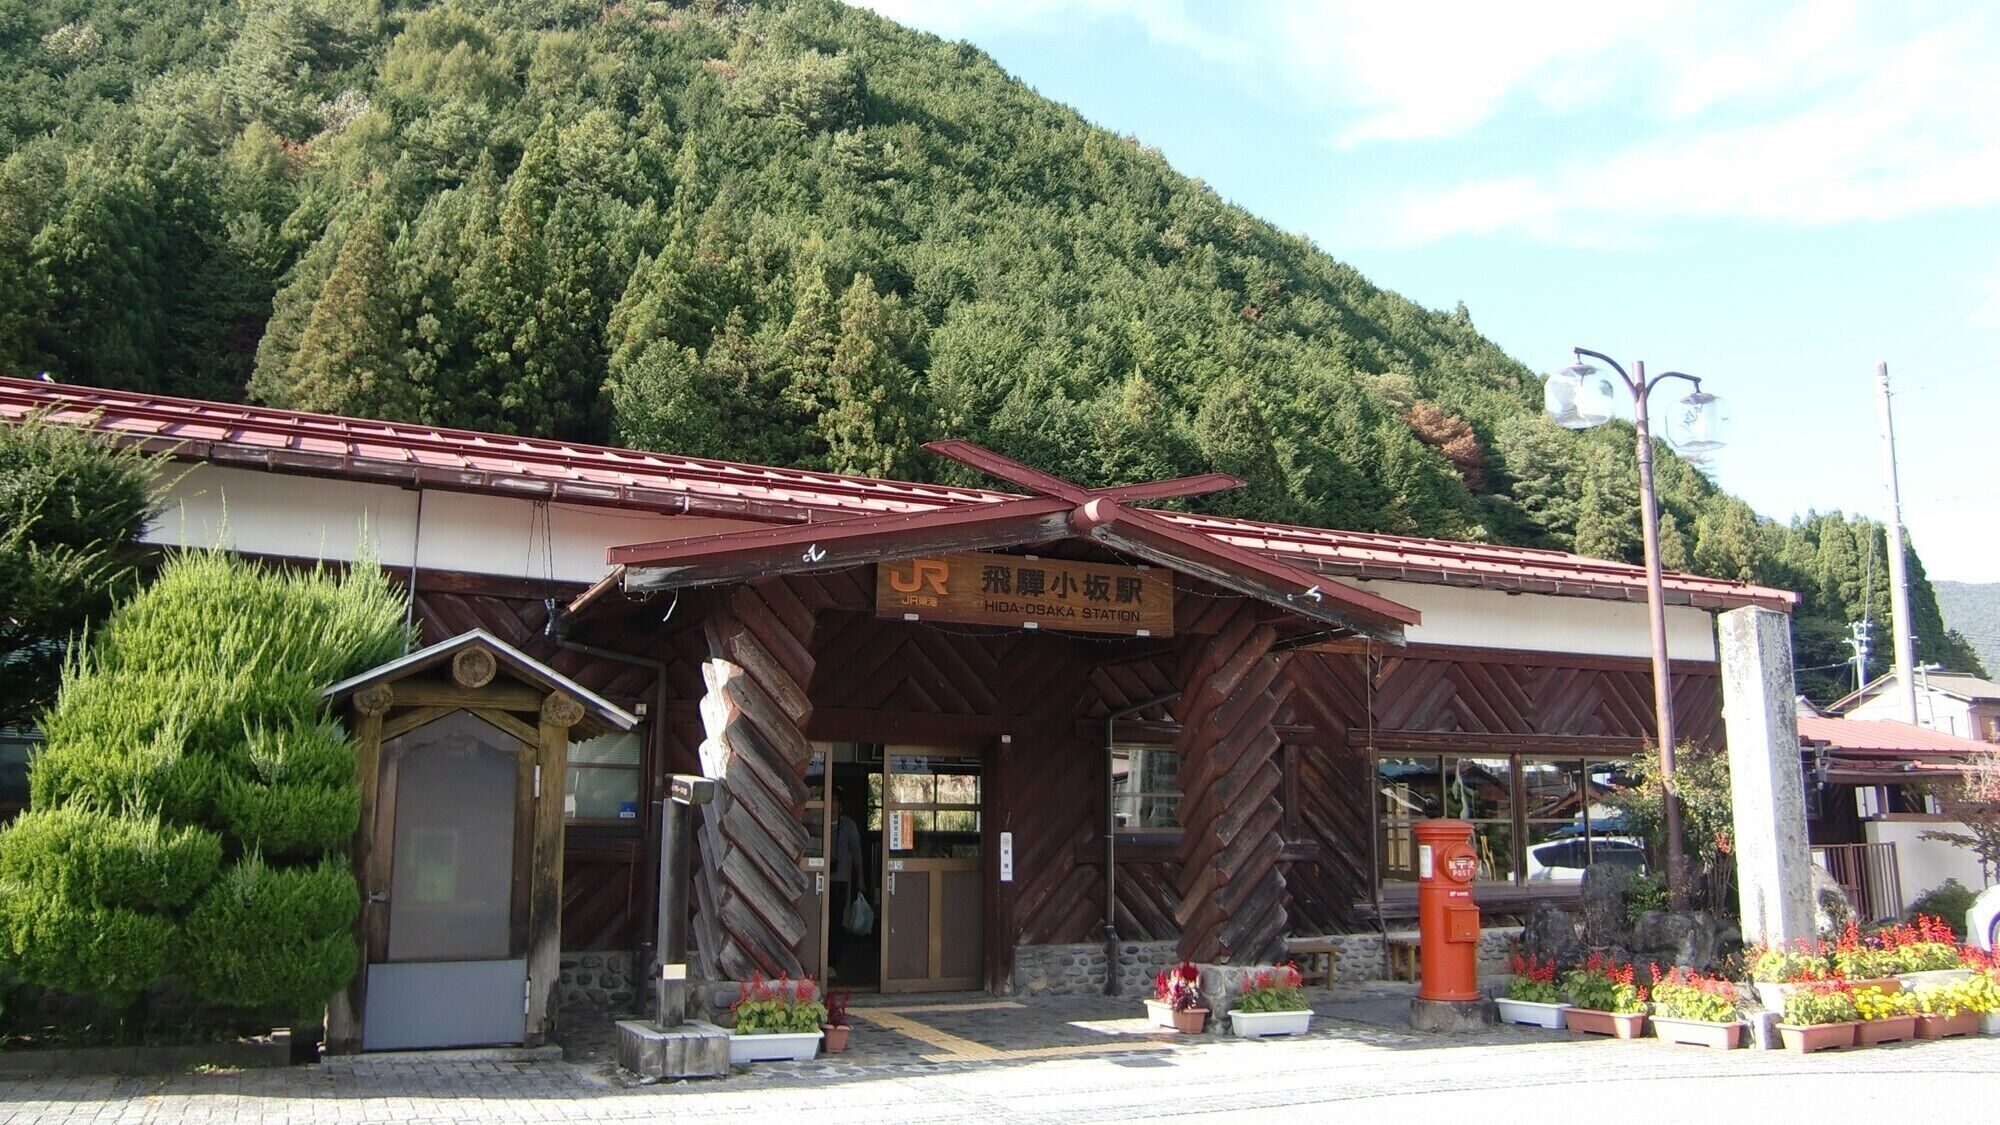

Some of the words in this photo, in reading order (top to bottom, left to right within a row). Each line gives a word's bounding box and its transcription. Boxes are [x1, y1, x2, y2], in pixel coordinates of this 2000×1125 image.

[891, 560, 949, 595] JR
[985, 601, 1076, 618] HIDA-OSAKA
[1082, 608, 1141, 622] STATION
